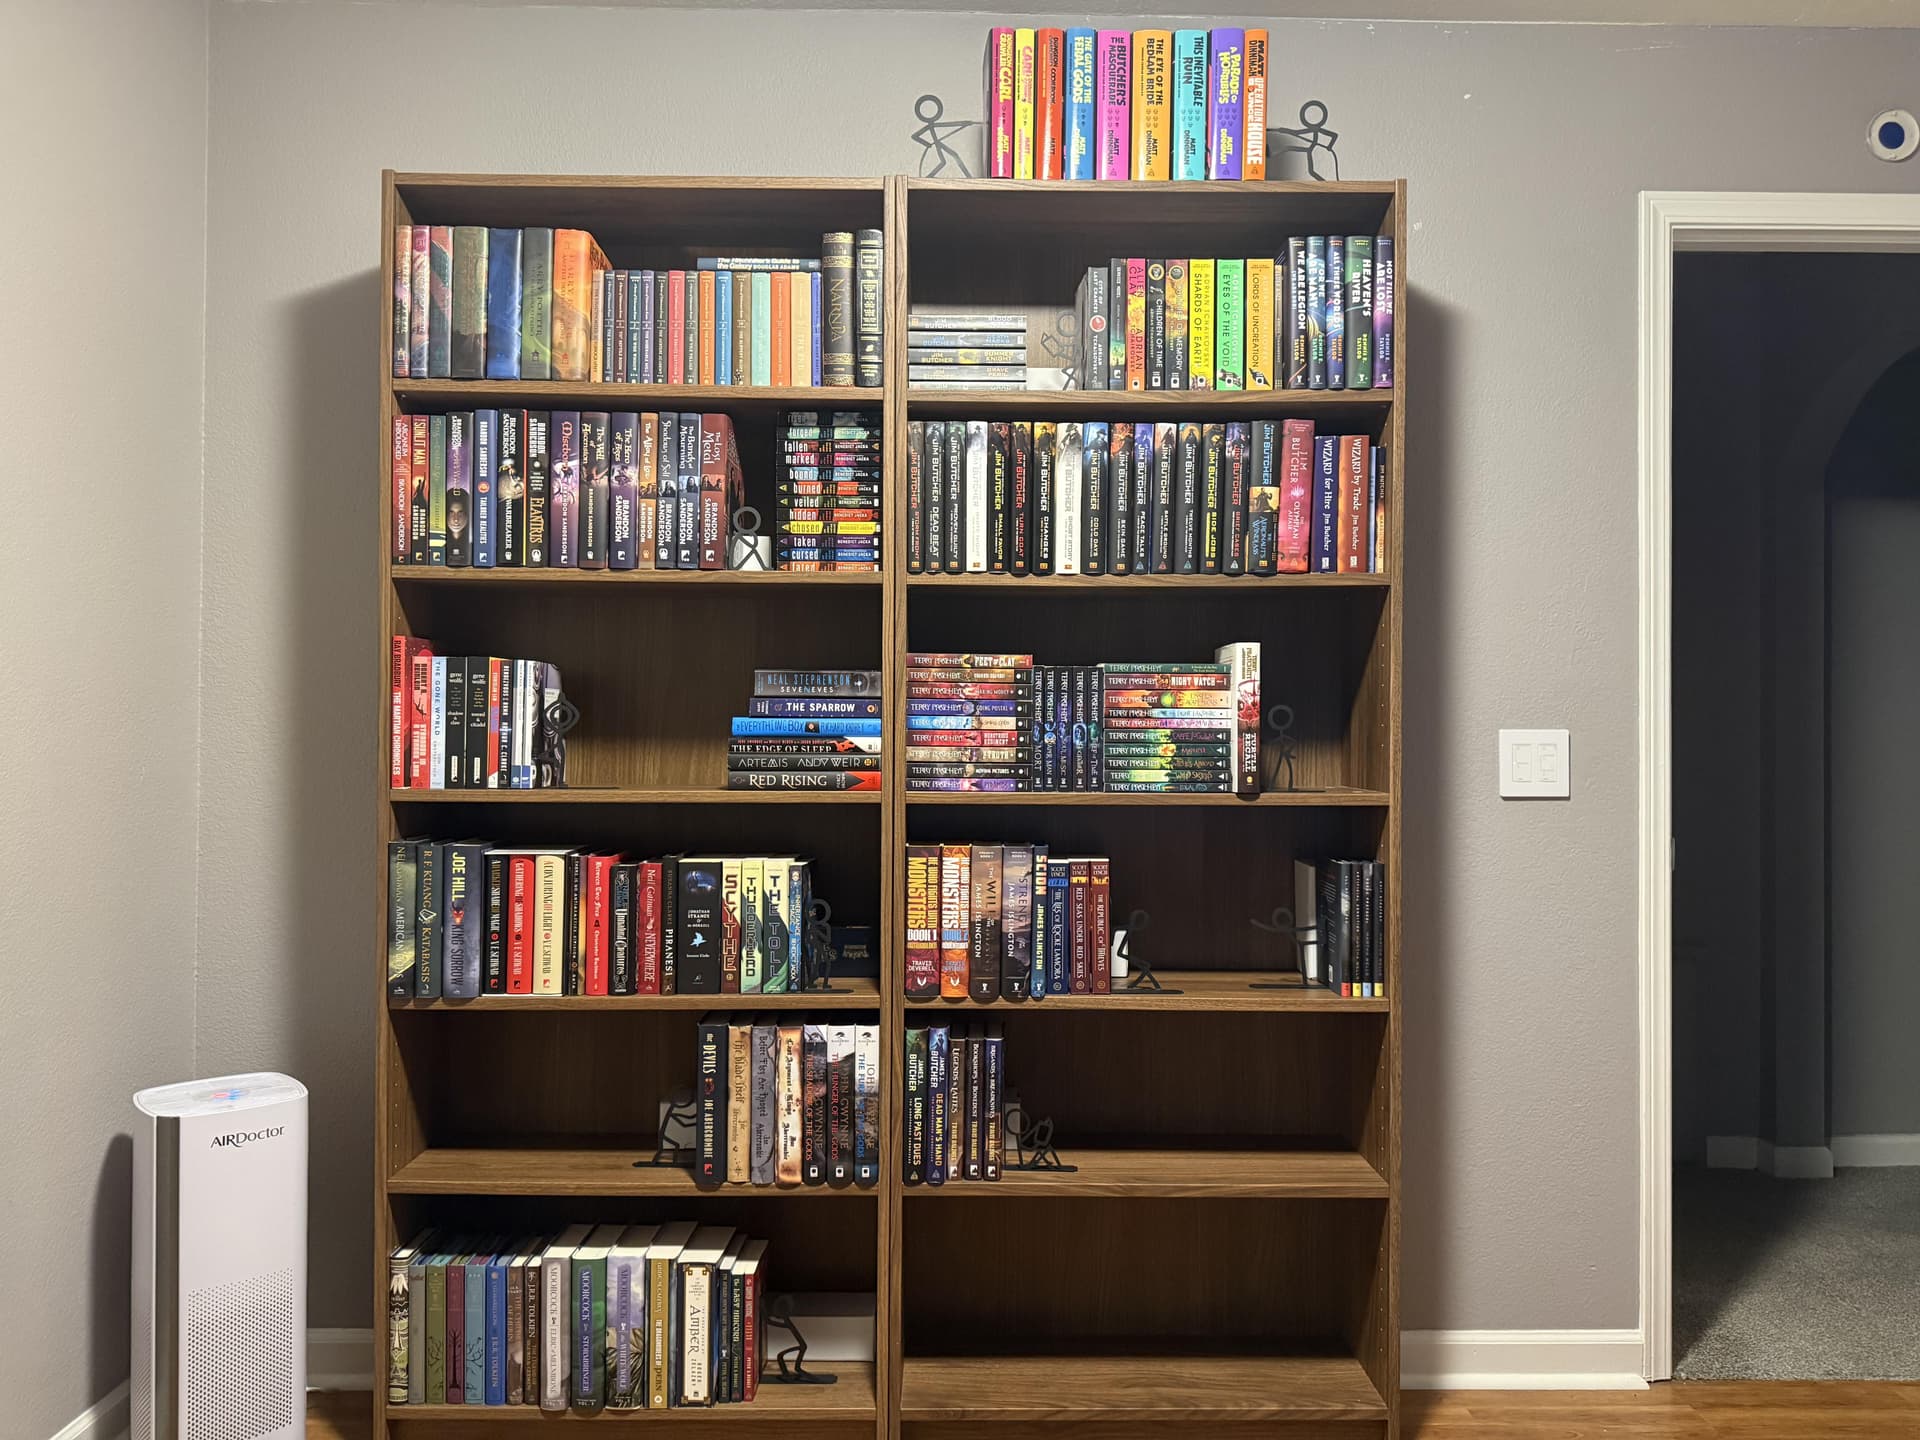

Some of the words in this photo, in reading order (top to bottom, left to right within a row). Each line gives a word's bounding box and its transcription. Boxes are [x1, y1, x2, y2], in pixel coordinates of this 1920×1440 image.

[1074, 36, 1084, 67] FERAL
[1146, 38, 1156, 75] BEDLAM
[1194, 36, 1204, 55] THIS
[1084, 75, 1092, 87] OF
[1108, 45, 1117, 106] MASQUERADE
[1117, 45, 1126, 106] BUTCHER'S
[1156, 75, 1164, 87] OF
[1183, 57, 1193, 84] RUIN
[1194, 57, 1204, 107] INEVITABLE
[1000, 67, 1012, 103] CARL
[1073, 68, 1084, 104] GODS
[1147, 78, 1155, 106] BRIDE
[1248, 123, 1263, 164] HOUSE
[1298, 250, 1306, 265] WE
[1128, 266, 1138, 297] CLAY
[1136, 267, 1144, 298] ALIEN
[1222, 274, 1230, 297] EYES
[1298, 268, 1306, 288] ARE
[1352, 272, 1360, 304] RIVER
[1362, 259, 1372, 317] HEAVEN'S
[1376, 263, 1385, 286] ARE
[829, 278, 847, 343] NARNIA
[1223, 302, 1230, 317] OF
[1252, 304, 1260, 314] OF
[1298, 290, 1306, 330] LEGION
[1376, 288, 1385, 312] LOST
[1194, 318, 1202, 332] OF
[1136, 328, 1144, 370] ADRIAN
[1156, 338, 1163, 348] OF
[1222, 342, 1230, 367] VOID
[414, 422, 426, 446] SUNLIT
[529, 418, 538, 458] SANDERSON
[538, 422, 546, 454] BRANDON
[582, 424, 592, 464] Ascension
[702, 430, 716, 464] Metal
[784, 441, 808, 453] fallen
[414, 449, 426, 465] MAN
[786, 454, 815, 464] marked
[1290, 437, 1301, 484] BUTCHER
[1352, 438, 1362, 474] WIZARD
[1351, 475, 1362, 486] by
[795, 496, 818, 508] veiled
[1352, 487, 1362, 511] Trade
[530, 497, 544, 544] ELANTRIS
[792, 522, 820, 533] chosen
[1292, 501, 1301, 539] OLYMPIAN
[1352, 514, 1360, 526] Jim
[794, 536, 816, 548] taken
[1352, 526, 1360, 550] Butcher
[792, 549, 818, 560] cursed
[394, 640, 402, 654] RAY
[768, 674, 788, 685] NEAL
[794, 674, 851, 686] STEPHENSON
[1170, 676, 1192, 686] NIGHT
[1194, 676, 1216, 686] WATCH
[393, 692, 402, 704] THE
[786, 702, 805, 712] THE
[810, 702, 855, 712] SPARROW
[393, 706, 401, 734] MARTIAN
[393, 736, 401, 775] CHRONICLES
[738, 758, 788, 768] ARTEMIS
[798, 758, 830, 768] ANDY
[830, 758, 861, 768] WEIR
[1034, 745, 1042, 771] MORT
[750, 774, 776, 789] RED
[781, 774, 828, 789] RISING
[424, 850, 432, 858] R.
[452, 852, 465, 874] JOE
[423, 870, 431, 908] KUANG
[452, 876, 464, 902] HILL
[1036, 855, 1047, 896] SCION
[768, 876, 781, 916] THE
[908, 856, 927, 928] MONSTERS
[942, 856, 960, 928] MONSTERS
[396, 906, 405, 951] AMERICAN
[452, 924, 464, 946] KING
[722, 874, 738, 971] SCYTHE
[421, 928, 432, 983] KATABASIS
[644, 932, 657, 983] NEVERWHERE
[665, 928, 674, 976] PIRANESI
[768, 922, 781, 977] TOLL
[1036, 930, 1044, 970] ISLINGTON
[451, 948, 464, 986] SORROW
[703, 1045, 716, 1074] DEVILS
[952, 1048, 960, 1081] LEGENDS
[705, 1099, 714, 1112] JOE
[914, 1098, 922, 1120] LONG
[950, 1087, 959, 1114] LATTES
[210, 1126, 284, 1148] AIRDoctor
[704, 1113, 713, 1158] ABERCROMBIE
[914, 1121, 922, 1142] PAST
[936, 1117, 944, 1142] MAN'S
[913, 1143, 922, 1166] DUES
[935, 1144, 944, 1166] HAND
[528, 1284, 536, 1302] J.R.R.
[582, 1271, 591, 1321] MOORCOCK
[528, 1305, 536, 1338] TOLKIEN
[688, 1304, 700, 1355] AMBER
